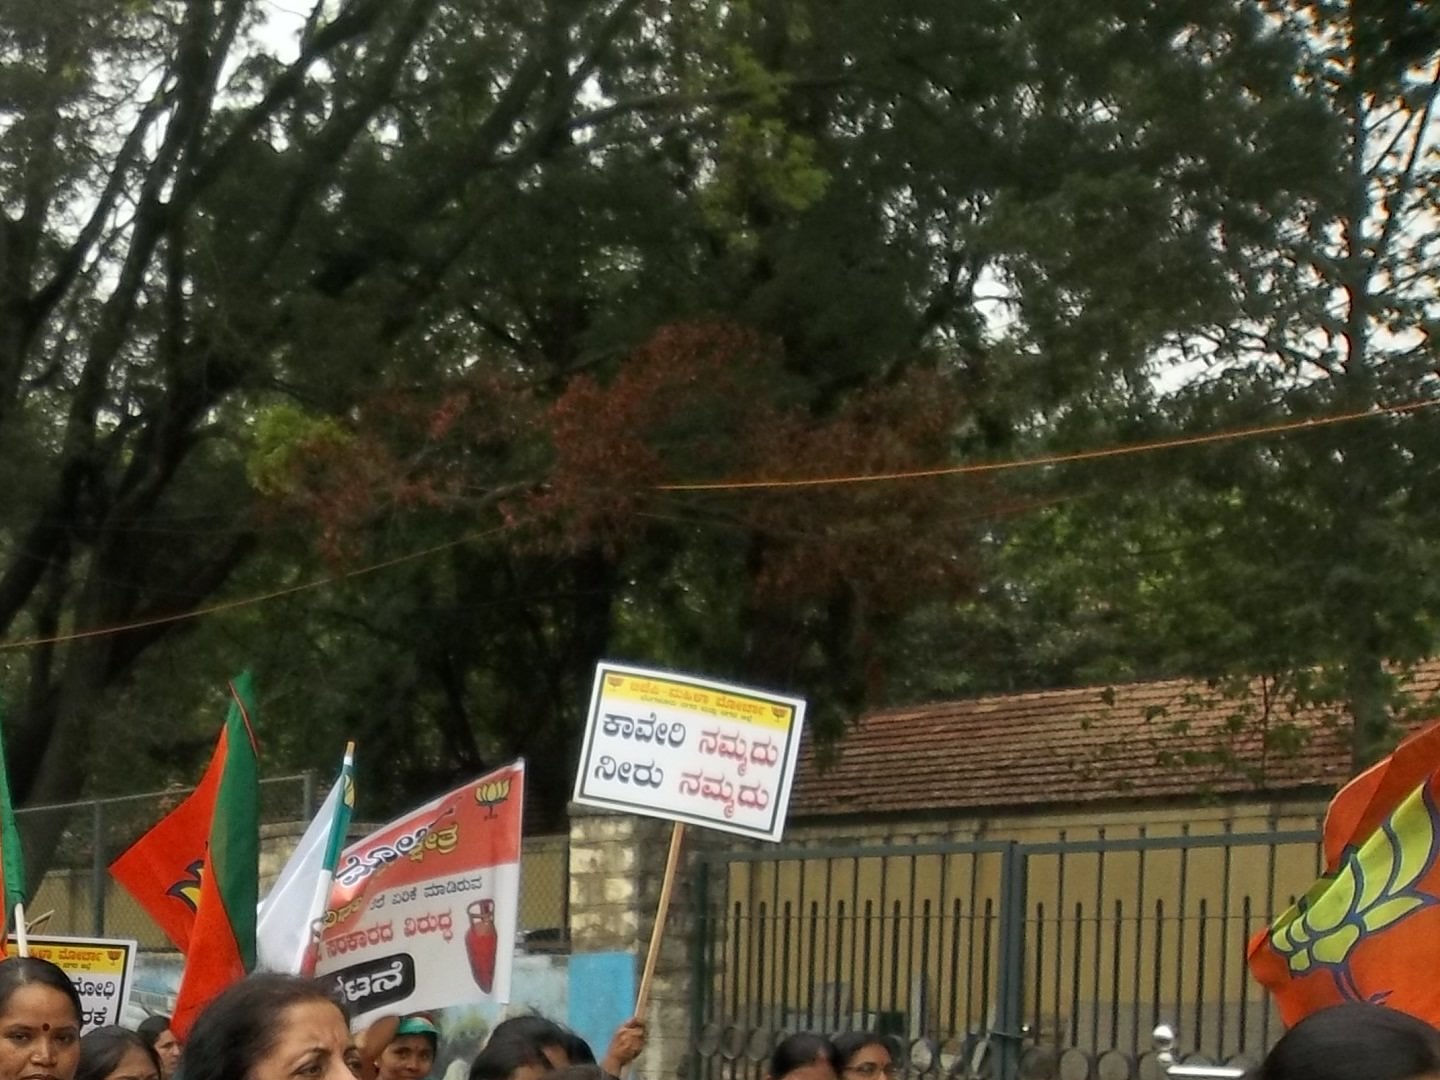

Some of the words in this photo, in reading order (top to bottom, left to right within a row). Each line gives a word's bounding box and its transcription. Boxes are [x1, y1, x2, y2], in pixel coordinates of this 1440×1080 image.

[603, 712, 686, 748] ಕಾವೇರಿ
[699, 726, 779, 776] ನಮ್ಮದು
[594, 755, 665, 789] ನೀರು
[678, 768, 770, 819] ನಮ್ಮದು
[71, 976, 116, 1000] ರೋಧಿ
